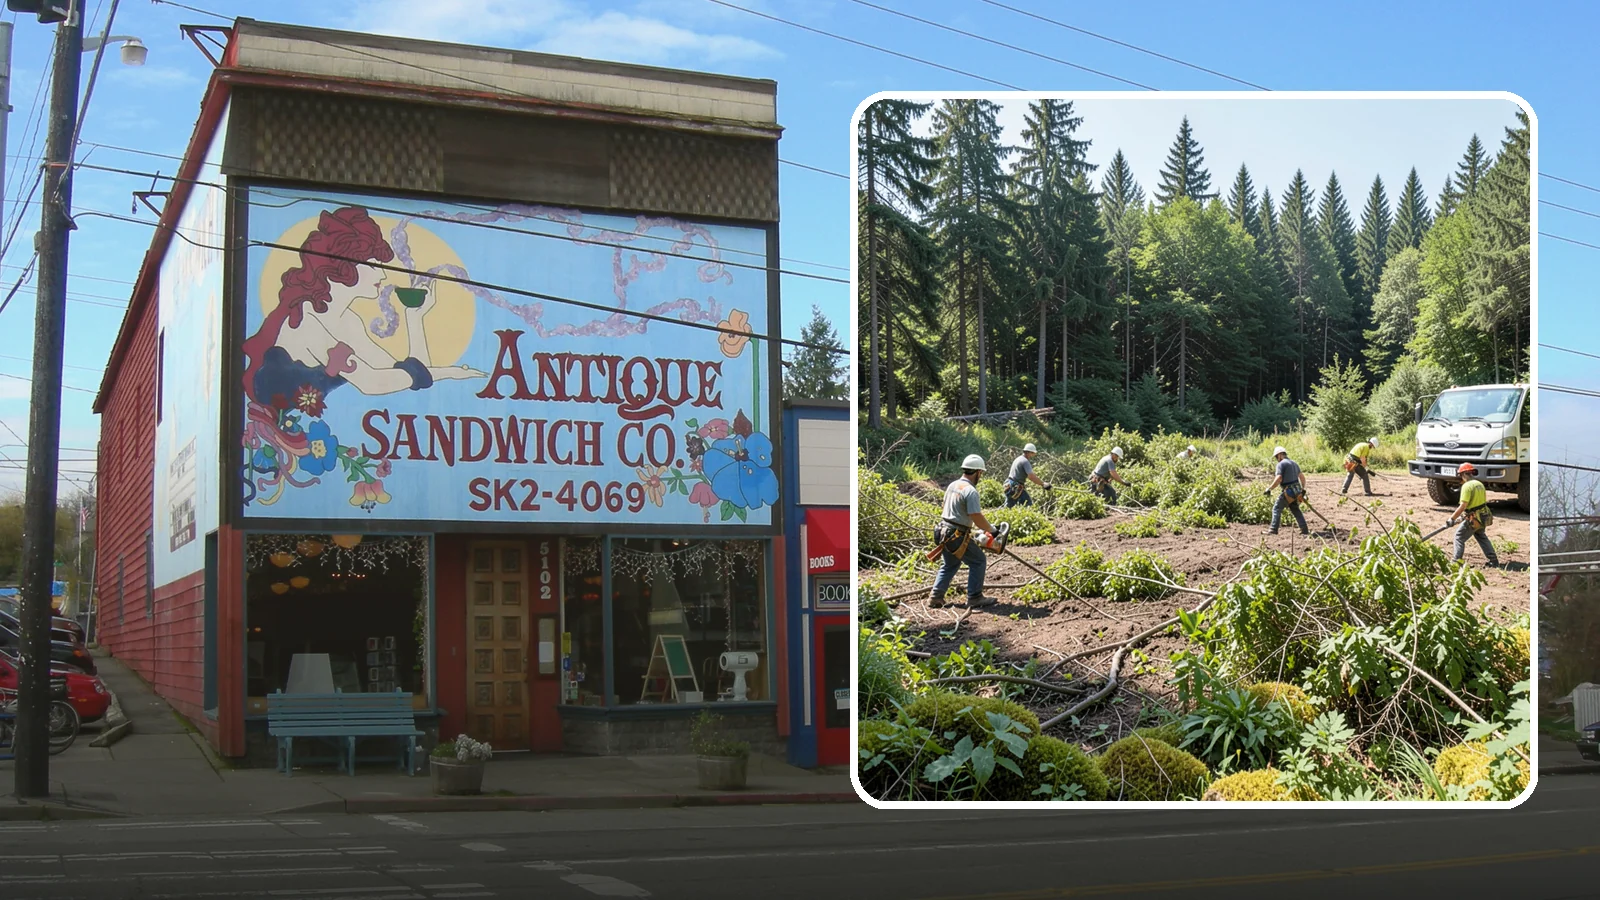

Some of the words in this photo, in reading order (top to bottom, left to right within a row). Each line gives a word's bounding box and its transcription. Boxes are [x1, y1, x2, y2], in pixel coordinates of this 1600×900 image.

[476, 329, 724, 421] ANTIQUE
[362, 407, 604, 467] SANDWICH
[616, 421, 686, 469] CO.
[468, 476, 647, 513] SK2-4069
[540, 541, 552, 600] 5102
[809, 555, 835, 569] BOOKS
